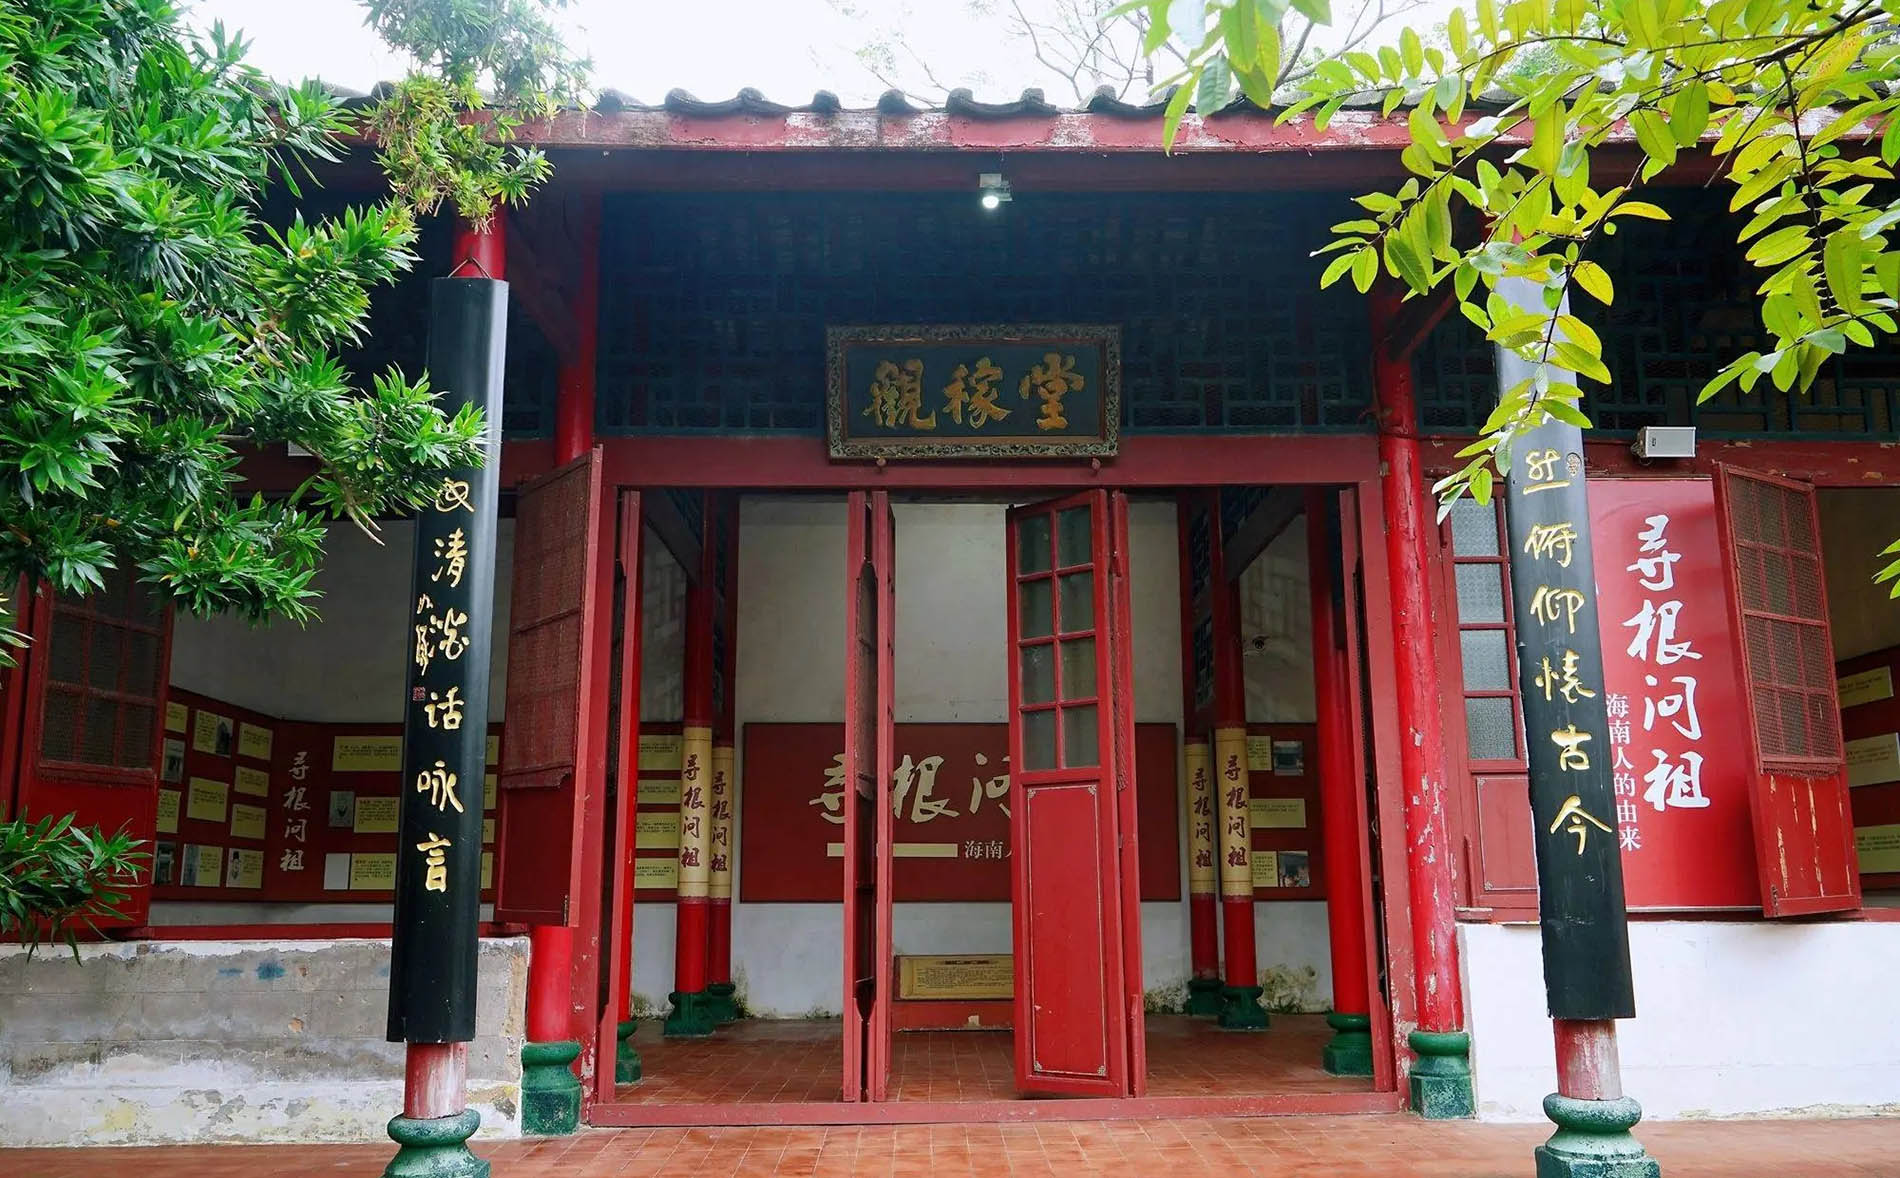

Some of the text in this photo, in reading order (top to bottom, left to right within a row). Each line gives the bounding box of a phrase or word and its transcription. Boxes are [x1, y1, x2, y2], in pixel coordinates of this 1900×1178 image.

[1622, 514, 1710, 811] 寻根问祖
[280, 752, 311, 872] 寻根问祖
[680, 753, 705, 868] 寻根问祖
[709, 771, 732, 873] 寻根问祖
[1192, 768, 1212, 869] 寻根问祖
[1224, 755, 1248, 868] 寻根问祖
[1606, 693, 1641, 851] 海南人的由来
[965, 841, 1012, 860] 海南
